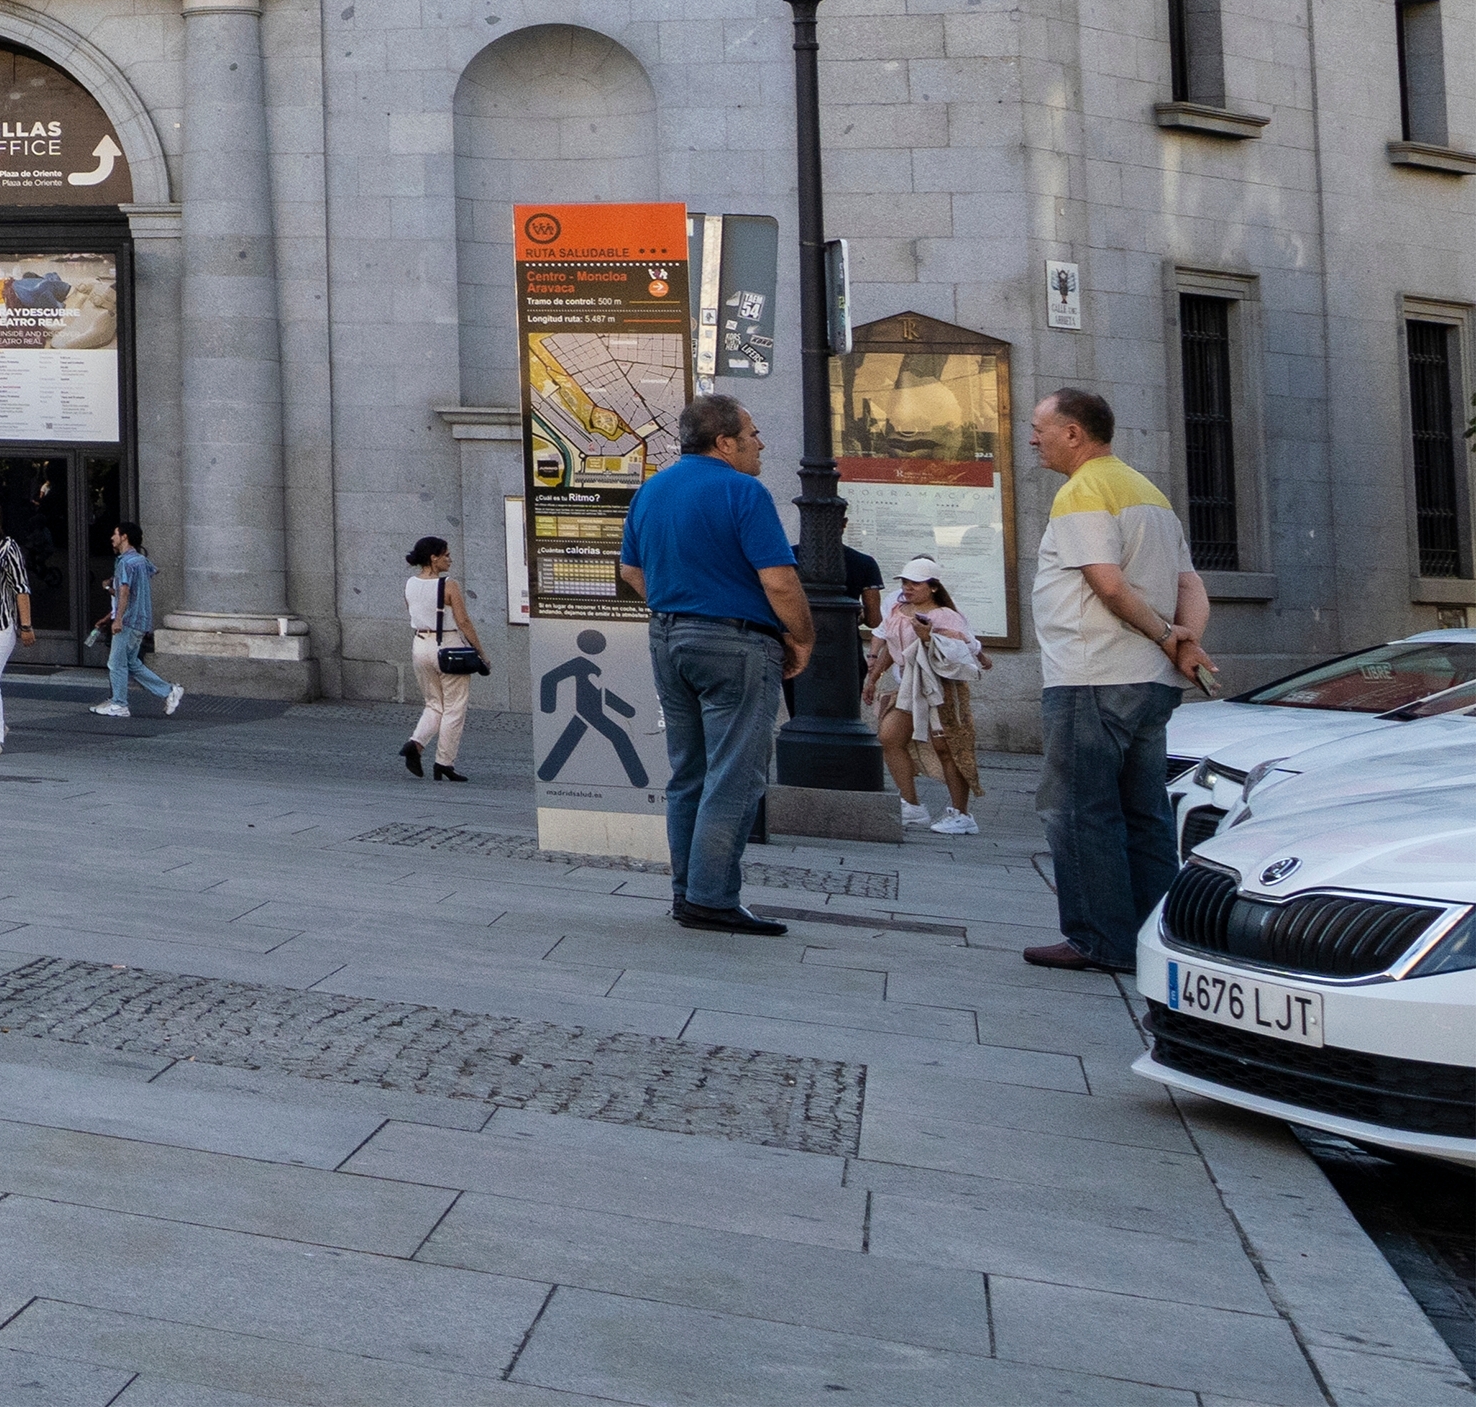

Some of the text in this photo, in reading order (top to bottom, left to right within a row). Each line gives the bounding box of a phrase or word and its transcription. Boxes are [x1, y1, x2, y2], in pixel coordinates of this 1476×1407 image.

[525, 248, 629, 258] RUTA SALUDABLE
[527, 271, 627, 281] Centro Moncloa
[527, 284, 575, 293] Aravaca
[741, 303, 759, 318] 54
[38, 318, 67, 326] REAL
[527, 315, 562, 324] Longitud
[568, 493, 600, 502] Ritmo?
[1361, 664, 1393, 680] LIBRE
[546, 789, 603, 798] madridsalud.es
[1183, 971, 1244, 1019] 4676
[1255, 988, 1312, 1036] LJT
